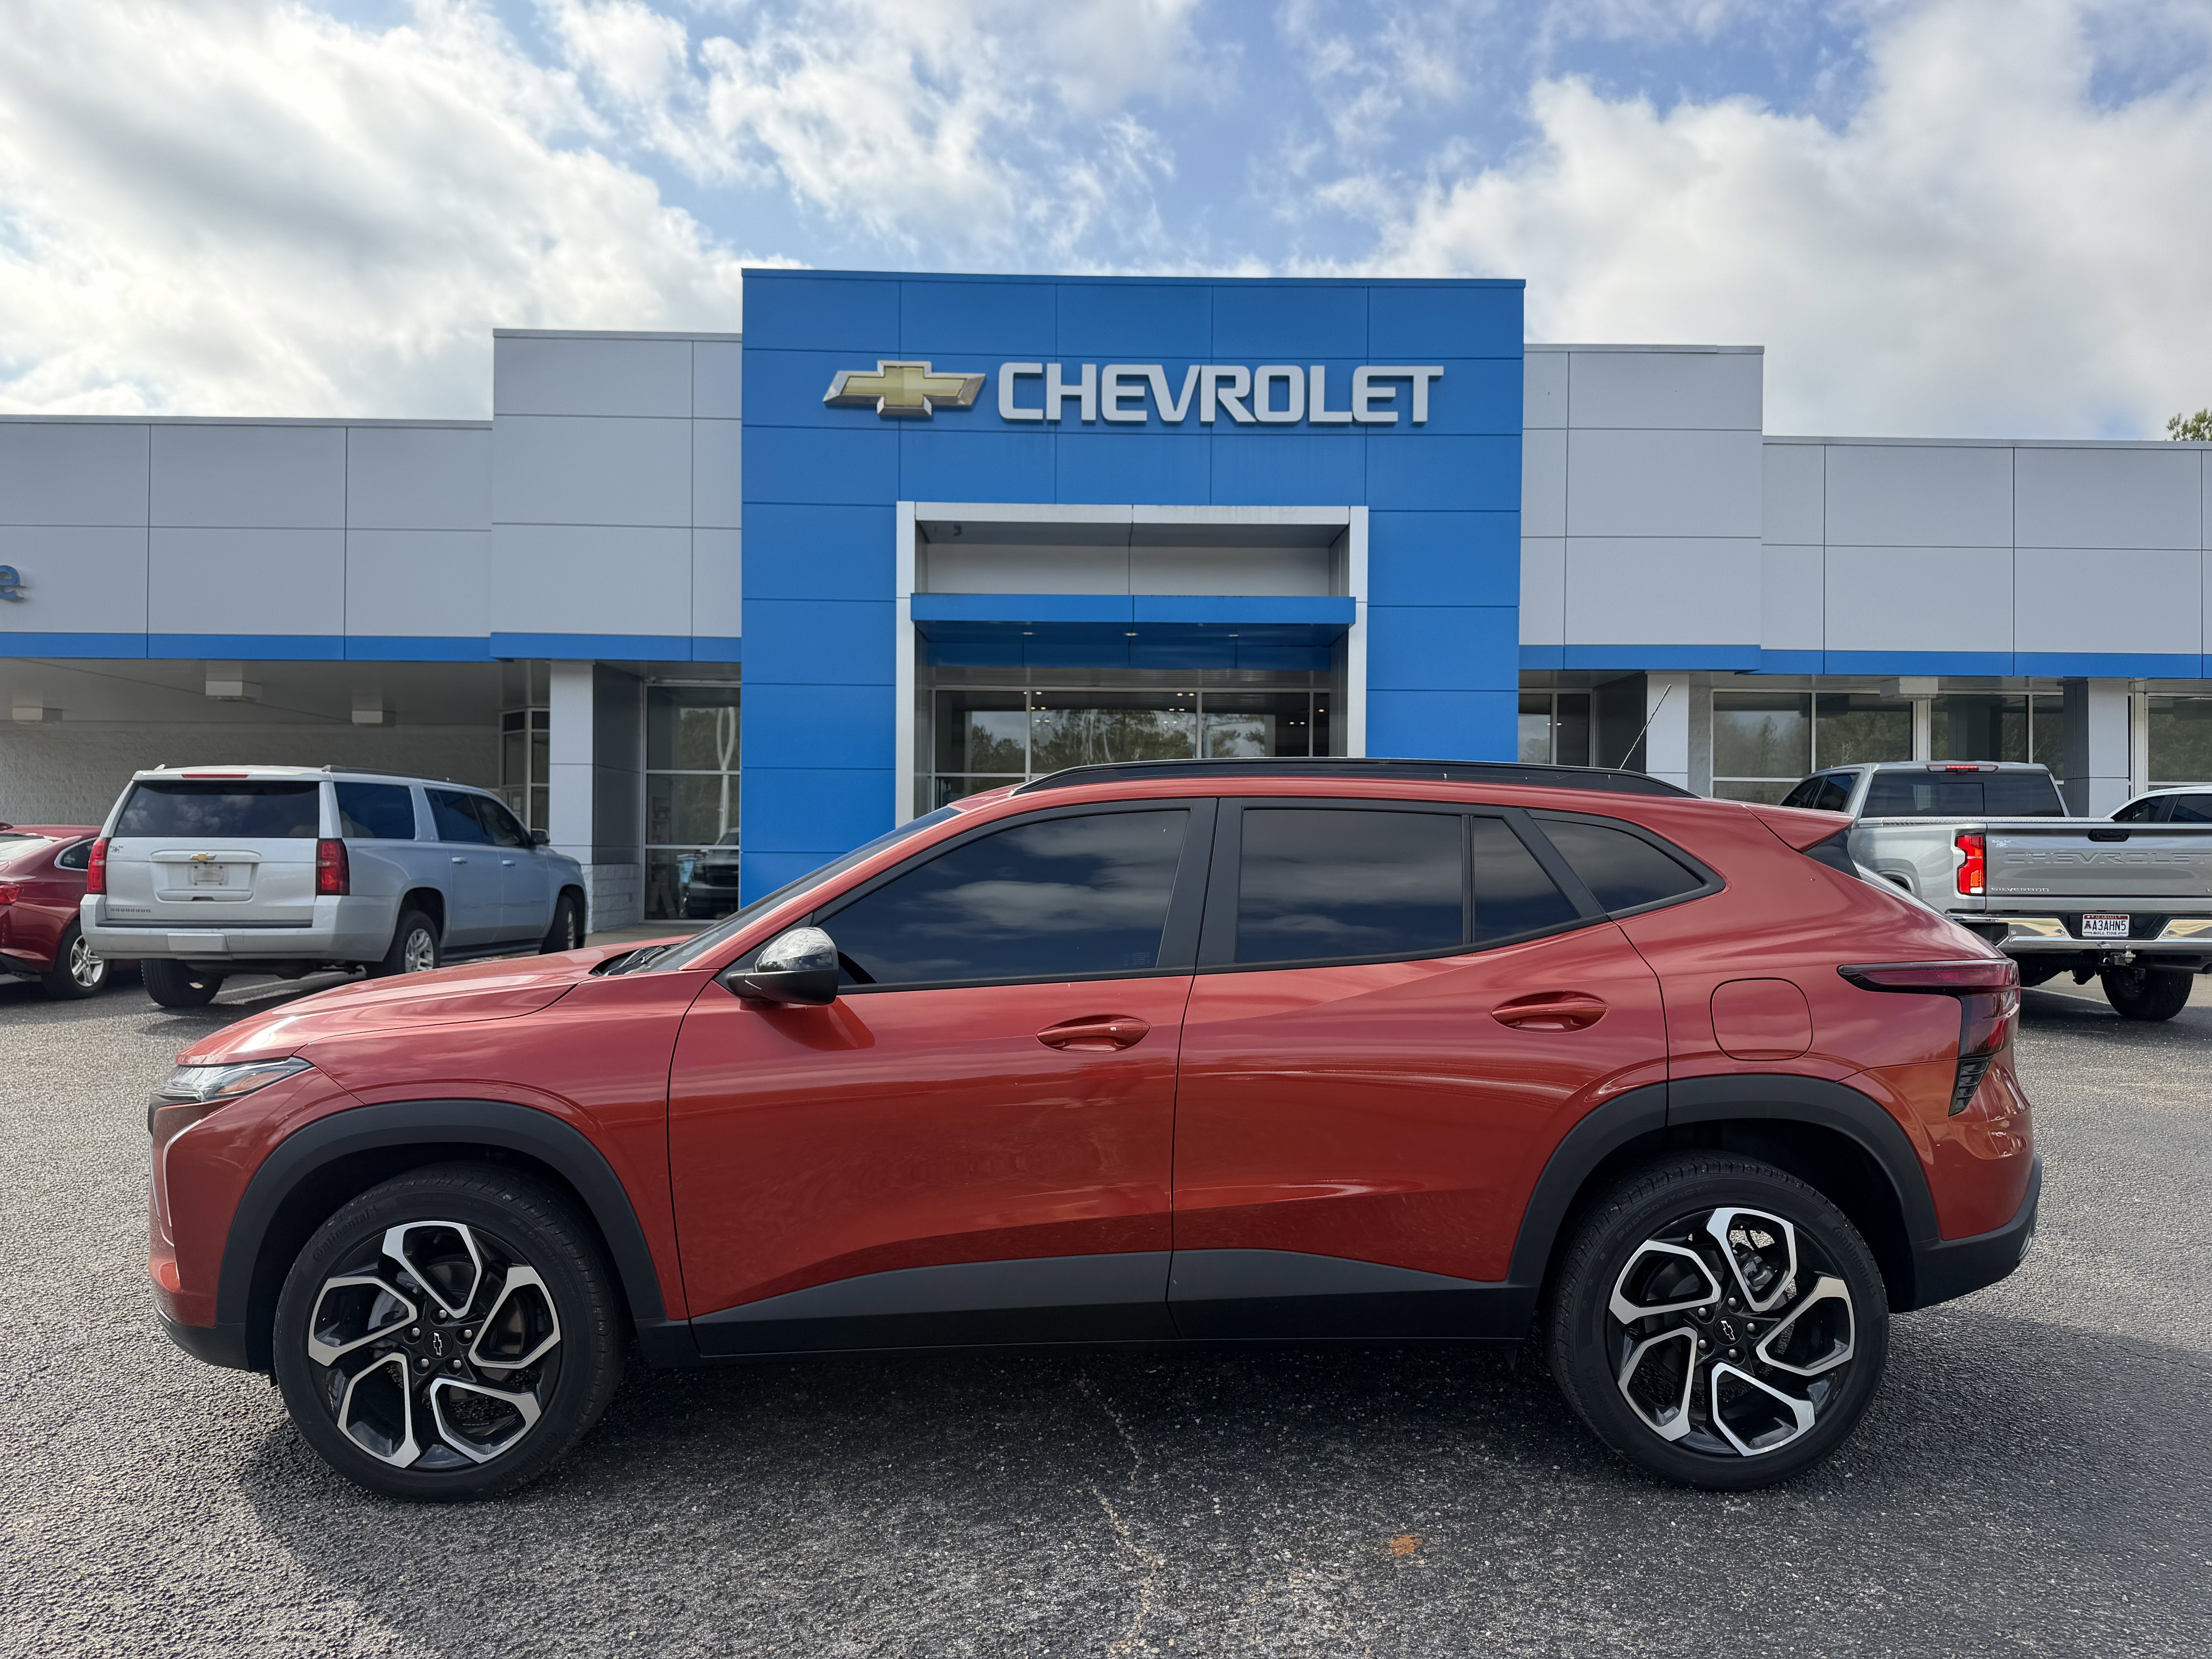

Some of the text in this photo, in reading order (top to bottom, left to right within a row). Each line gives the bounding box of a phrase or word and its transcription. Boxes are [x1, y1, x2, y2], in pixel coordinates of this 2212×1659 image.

[998, 362, 1444, 424] CHEVROLET
[2004, 852, 2212, 864] CHEVROLET
[2092, 920, 2126, 931] A3AHN5
